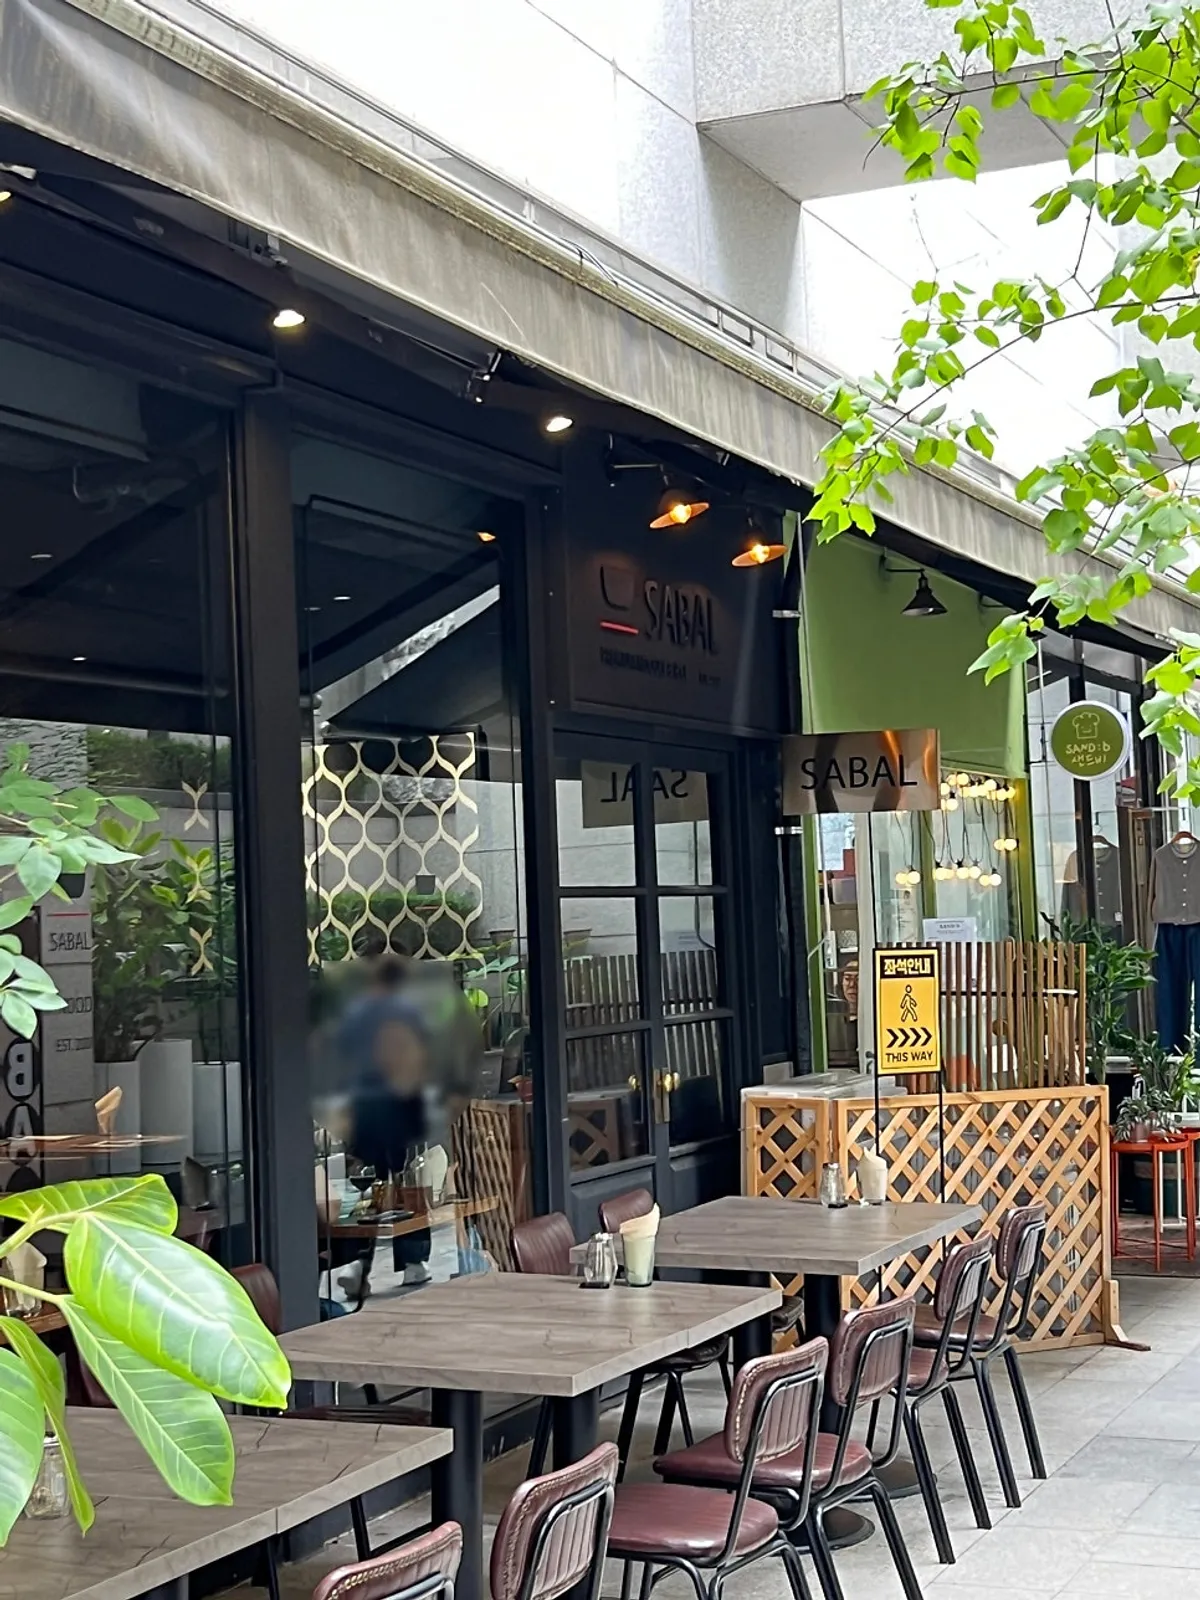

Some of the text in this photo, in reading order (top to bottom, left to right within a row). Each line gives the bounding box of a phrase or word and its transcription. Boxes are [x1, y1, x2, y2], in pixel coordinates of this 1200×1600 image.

[643, 580, 720, 655] SABAL
[801, 754, 918, 790] SABAL
[49, 931, 91, 951] SABAL
[883, 957, 931, 975] 좌석안내
[885, 1051, 933, 1063] THIS WAY
